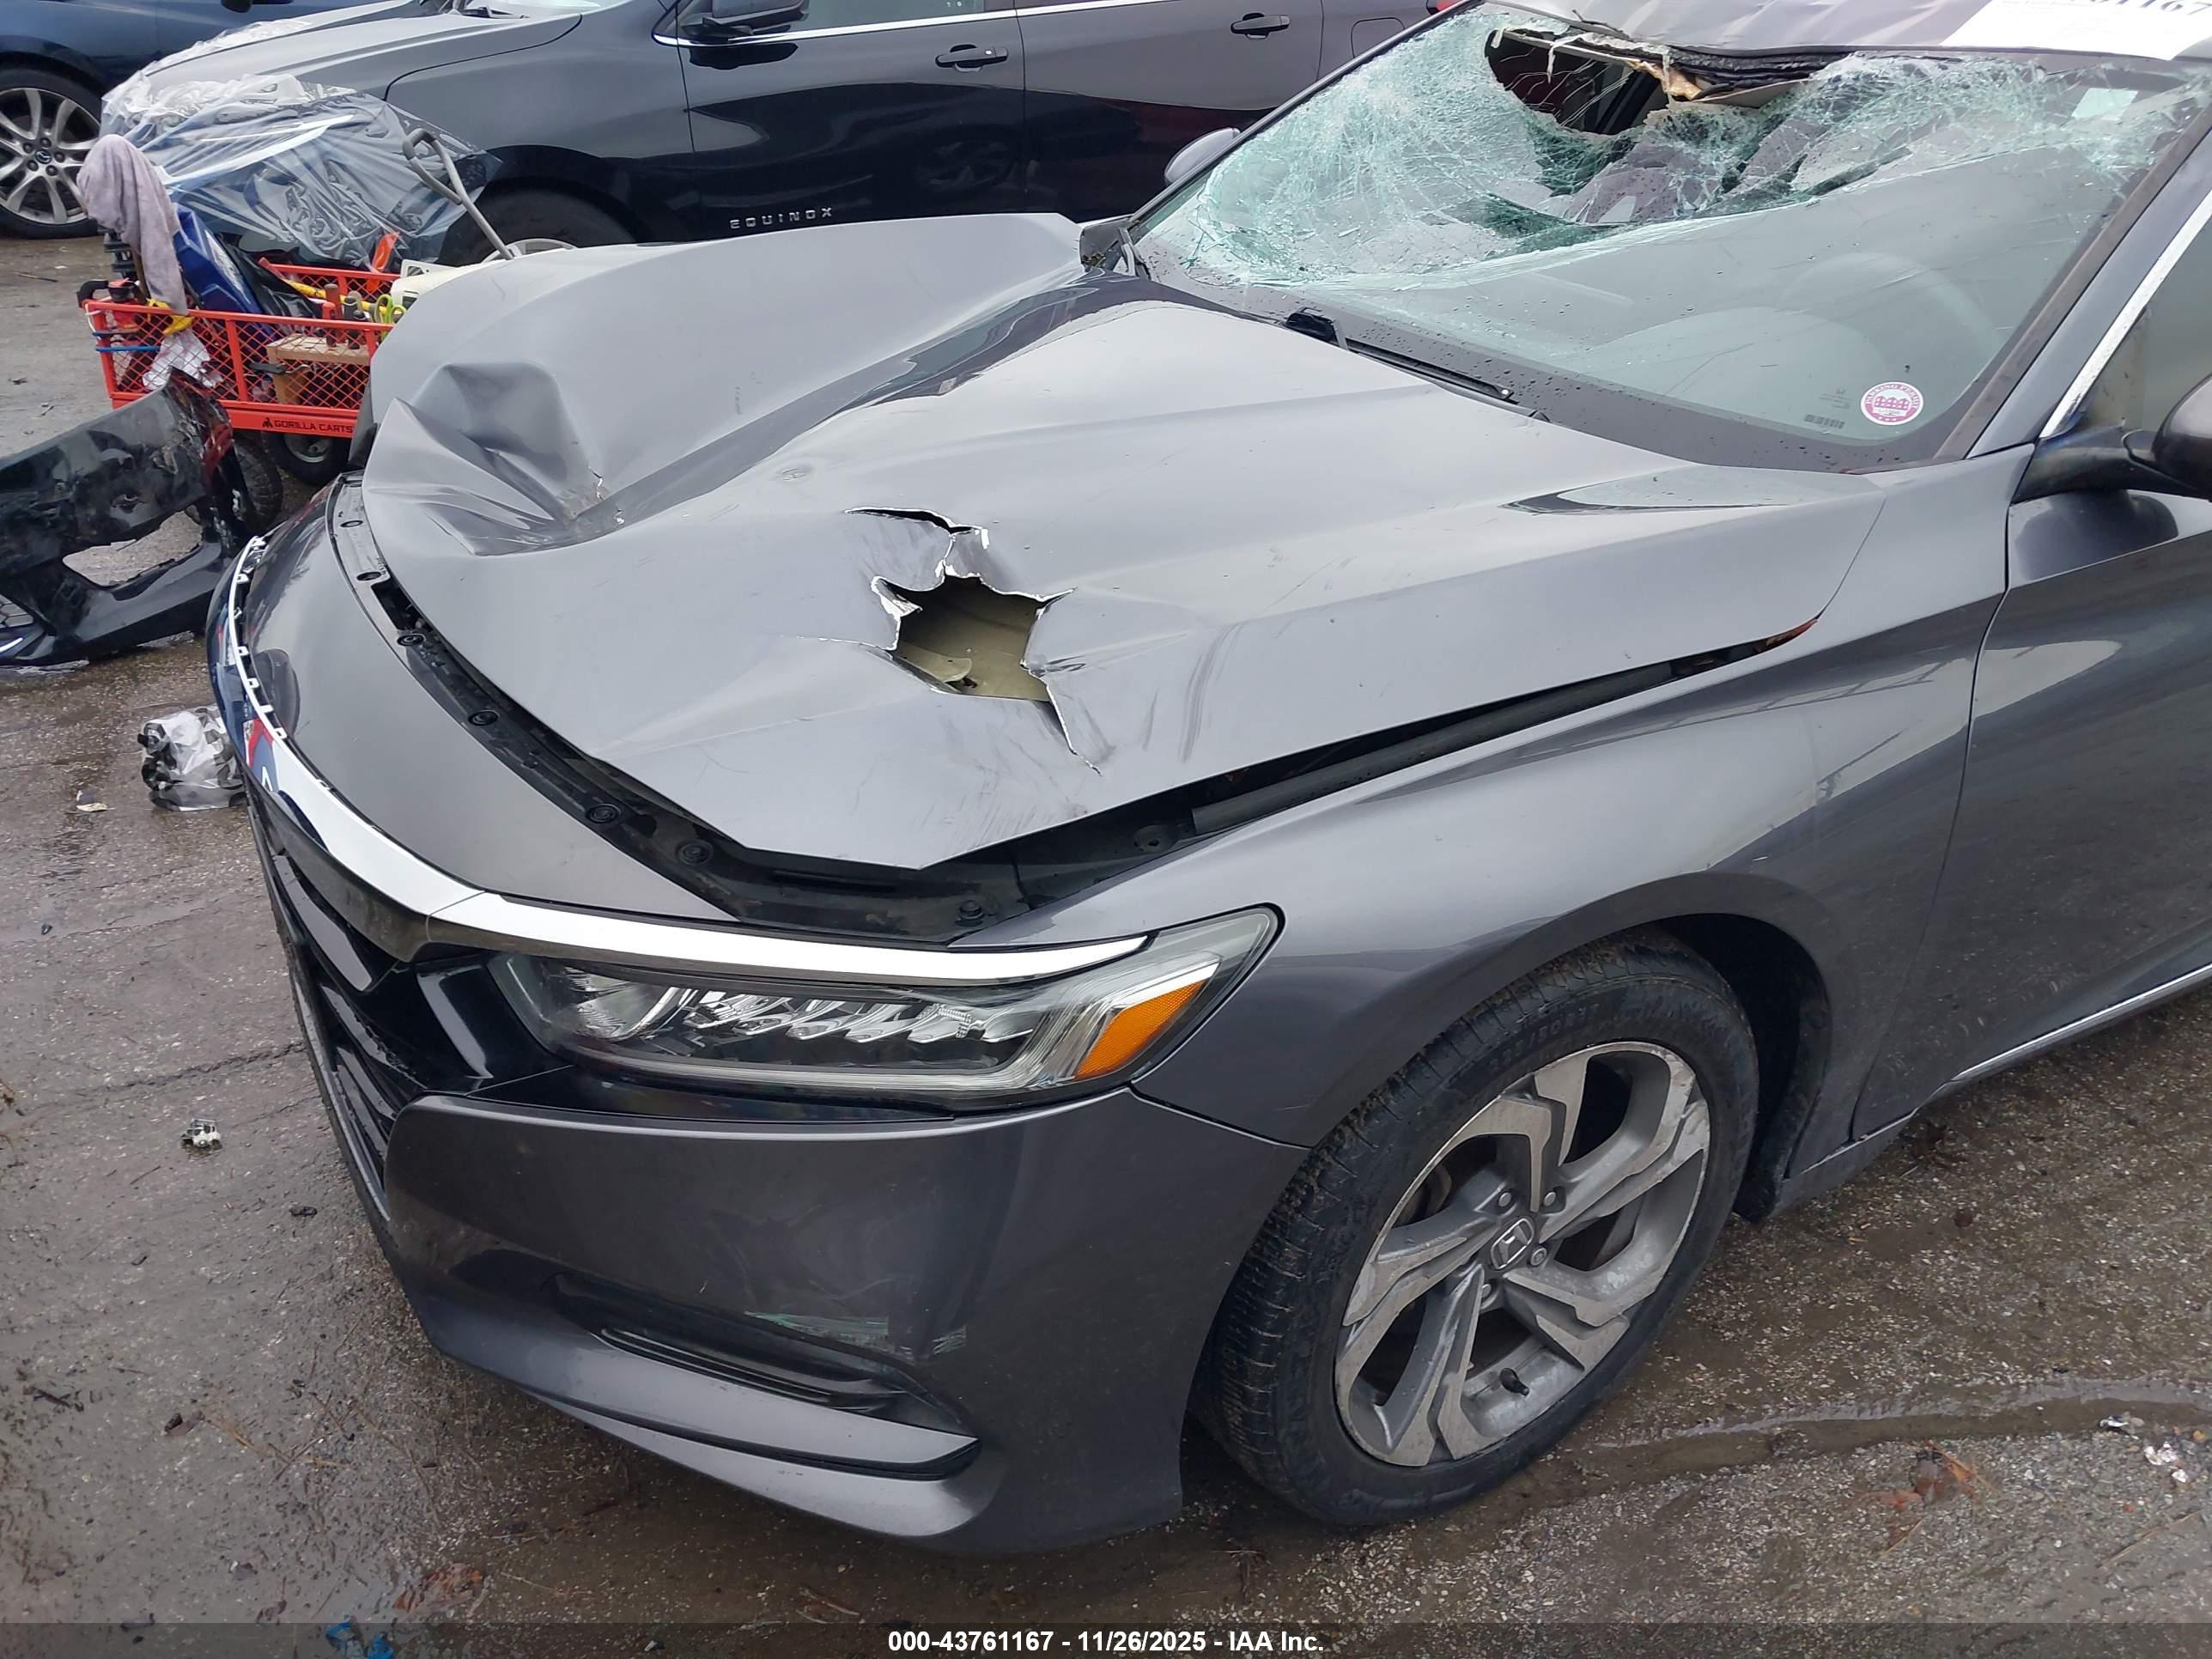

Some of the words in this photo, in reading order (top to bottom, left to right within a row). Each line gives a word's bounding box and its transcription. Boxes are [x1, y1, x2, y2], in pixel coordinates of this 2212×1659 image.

[729, 207, 833, 230] EQUINOX
[274, 419, 317, 430] GORILLA
[319, 423, 354, 434] CARTS
